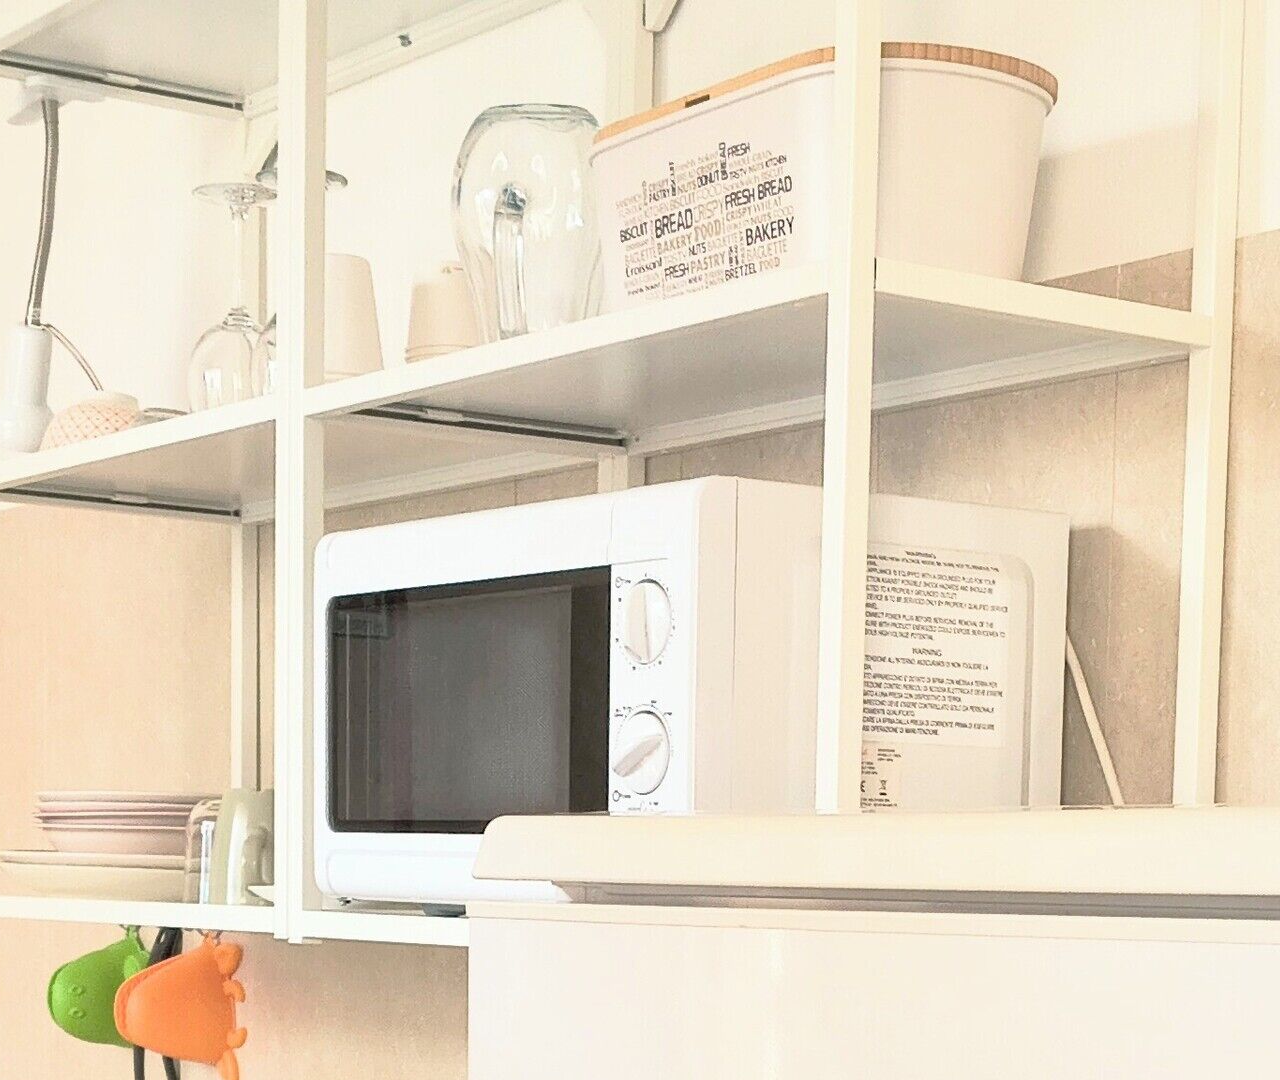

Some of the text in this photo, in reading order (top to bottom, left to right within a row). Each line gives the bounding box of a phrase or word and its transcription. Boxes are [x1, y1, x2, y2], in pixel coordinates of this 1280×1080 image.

[727, 142, 750, 158] FRESH
[724, 188, 755, 210] FRESH
[757, 175, 793, 200] BREAD
[655, 208, 693, 239] BREAD
[745, 216, 795, 247] BAKERY
[663, 263, 690, 281] FRESH
